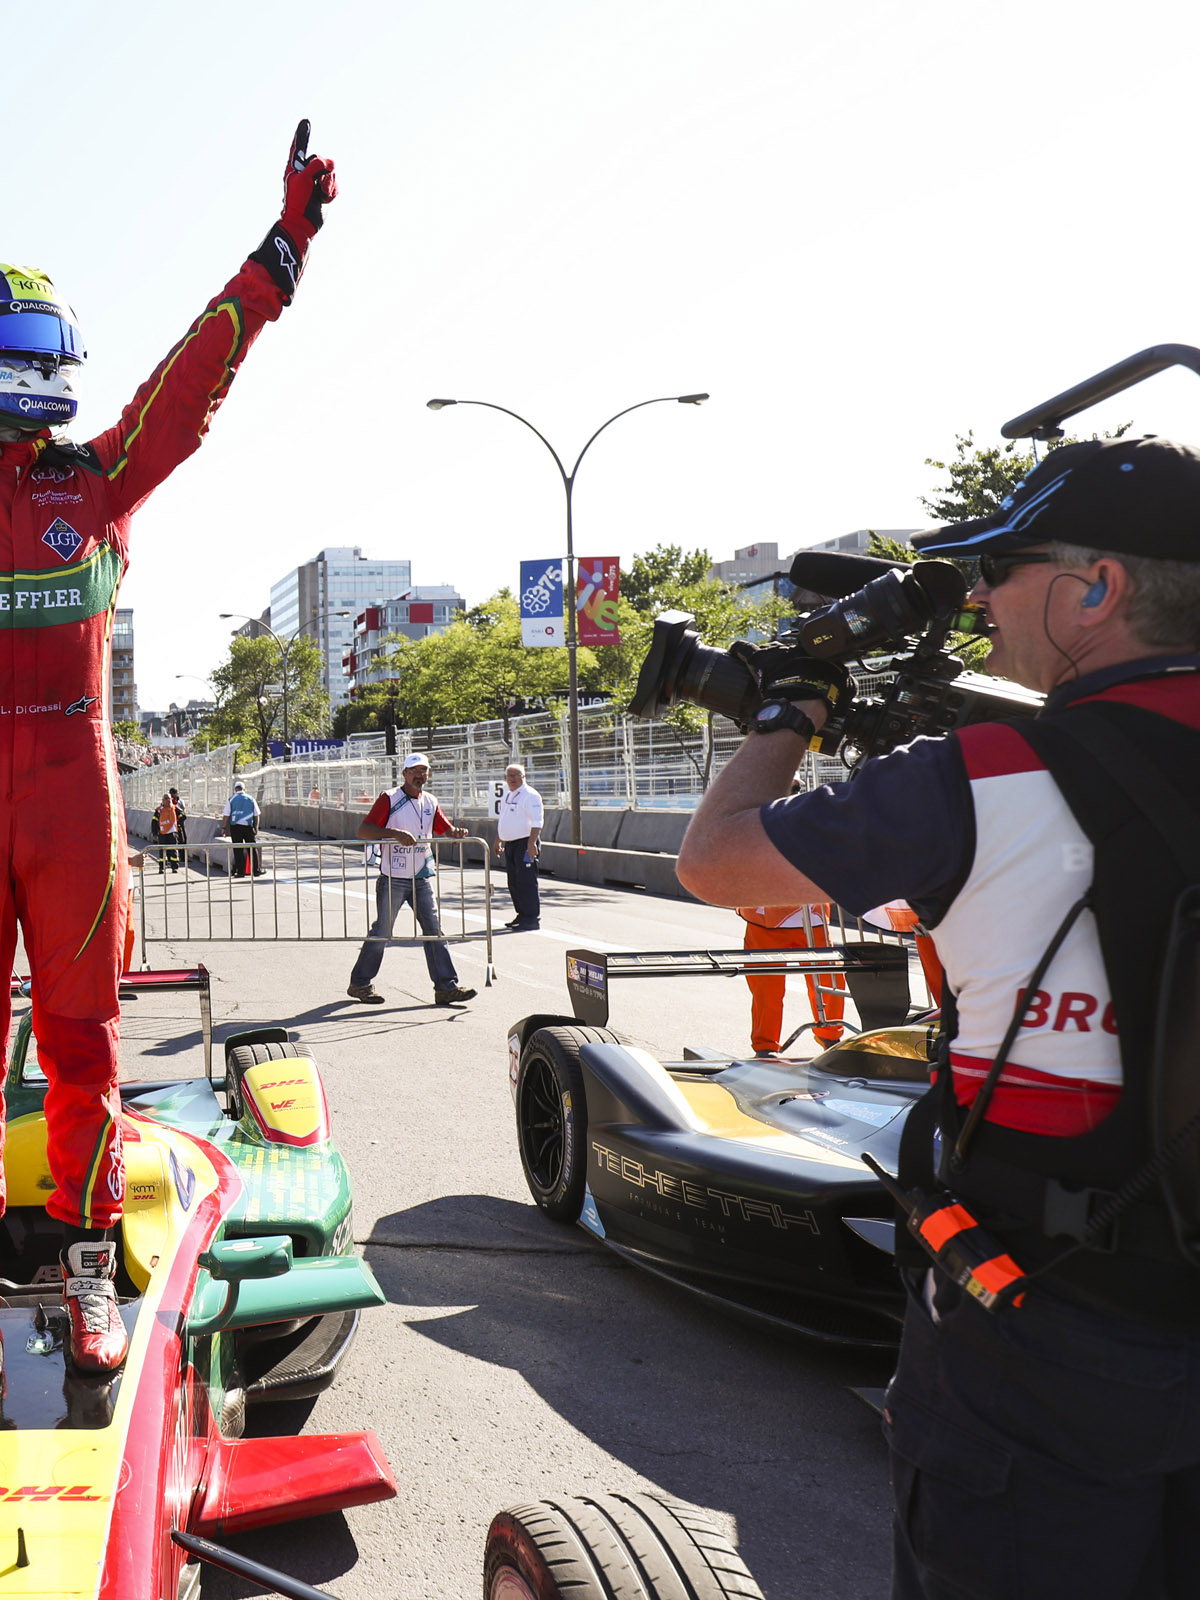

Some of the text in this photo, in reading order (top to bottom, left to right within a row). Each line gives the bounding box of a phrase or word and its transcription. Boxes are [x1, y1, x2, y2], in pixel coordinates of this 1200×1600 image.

[19, 397, 71, 412] QUALCOMM
[48, 531, 78, 547] LGT
[0, 705, 11, 714] L.
[257, 1079, 312, 1090] DHL
[591, 1141, 821, 1236] TECHEETAH
